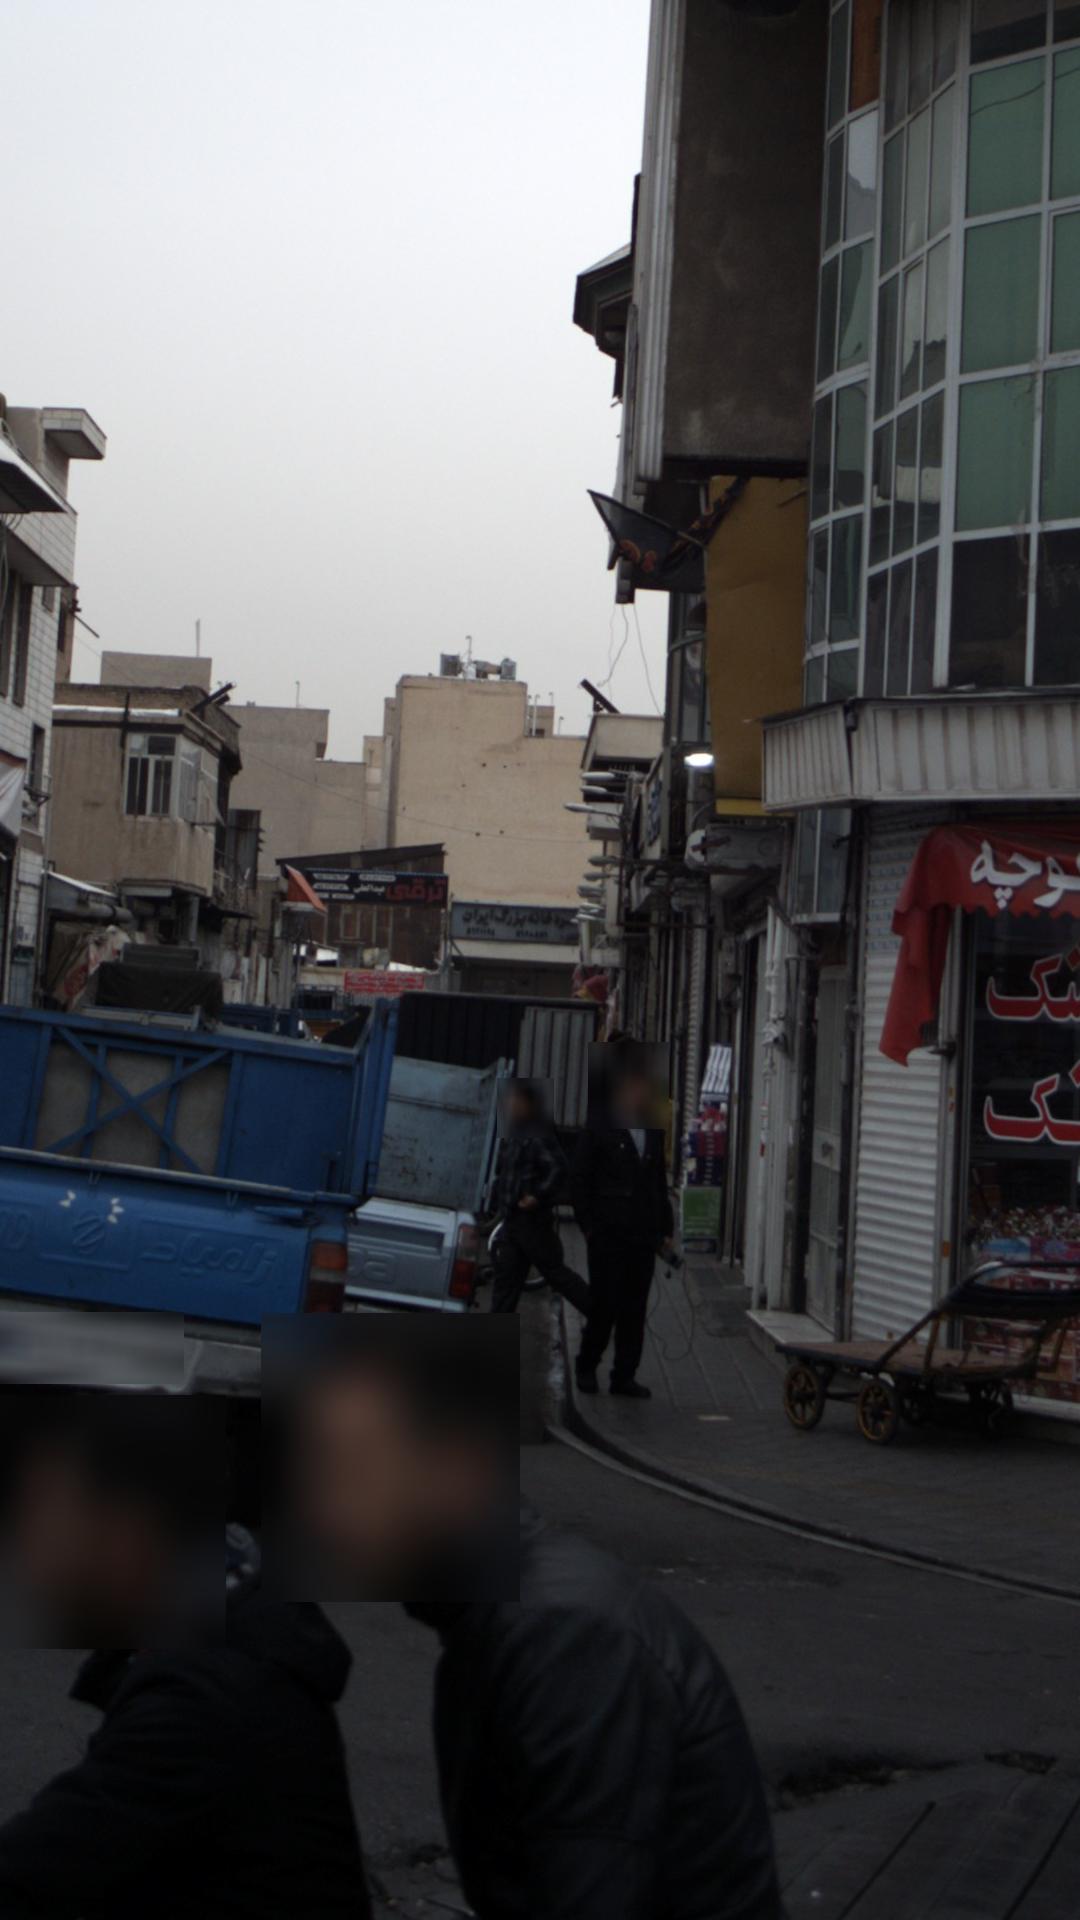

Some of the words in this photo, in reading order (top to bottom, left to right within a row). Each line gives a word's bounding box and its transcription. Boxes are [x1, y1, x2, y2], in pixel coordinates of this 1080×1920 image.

[969, 838, 1080, 910] وچه
[462, 908, 495, 927] ایران
[494, 908, 529, 930] بزرگ
